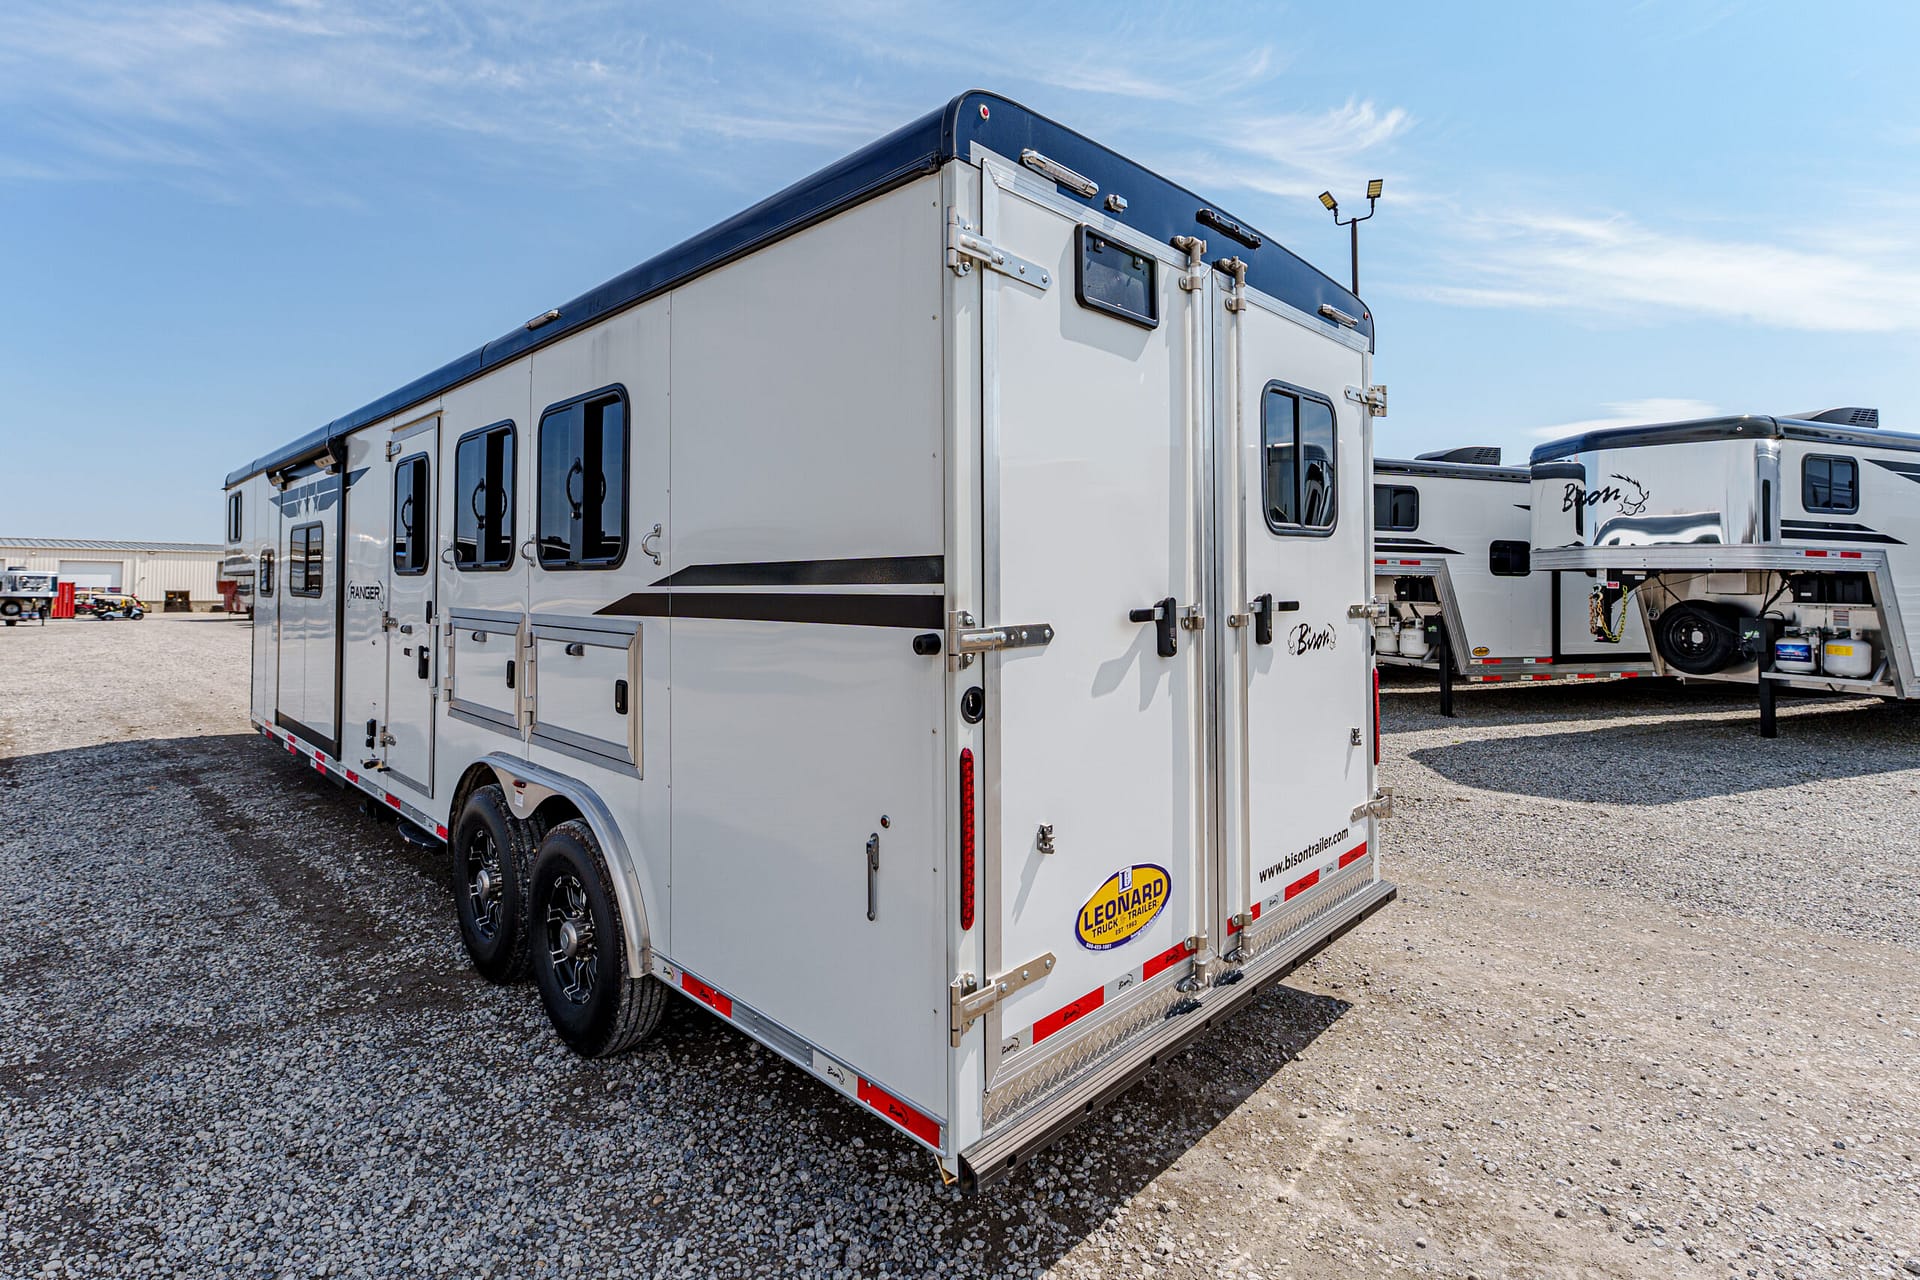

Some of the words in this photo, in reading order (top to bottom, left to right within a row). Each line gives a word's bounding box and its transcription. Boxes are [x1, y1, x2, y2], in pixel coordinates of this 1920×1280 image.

[350, 586, 380, 600] RANGER
[1297, 623, 1329, 655] Bison
[1259, 828, 1349, 883] www.bisontrailer.com
[1084, 878, 1163, 931] LEONARD
[1092, 918, 1119, 938] TRUCK
[1128, 900, 1157, 920] TRAILER
